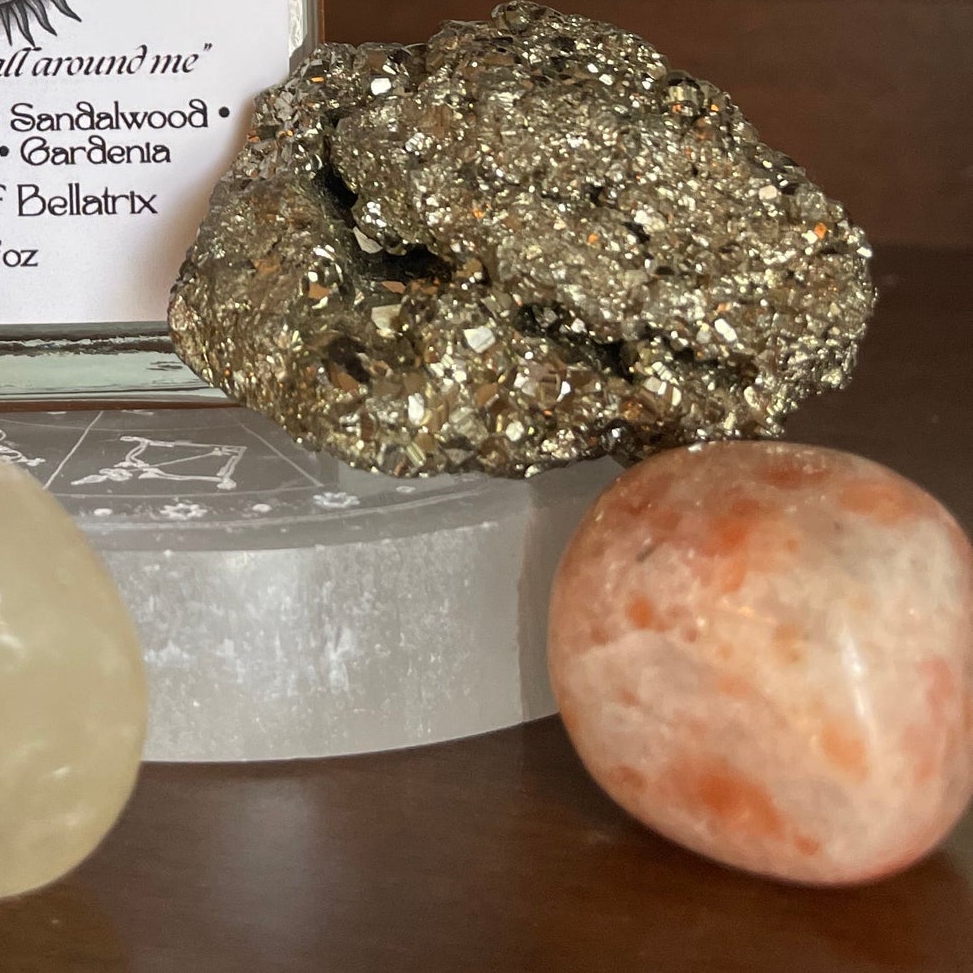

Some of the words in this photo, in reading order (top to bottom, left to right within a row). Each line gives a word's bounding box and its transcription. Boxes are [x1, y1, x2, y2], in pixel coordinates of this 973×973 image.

[31, 43, 148, 77] around
[9, 98, 209, 133] Sandalwood
[19, 134, 172, 167] Gardenia
[16, 182, 159, 218] Bellatrix
